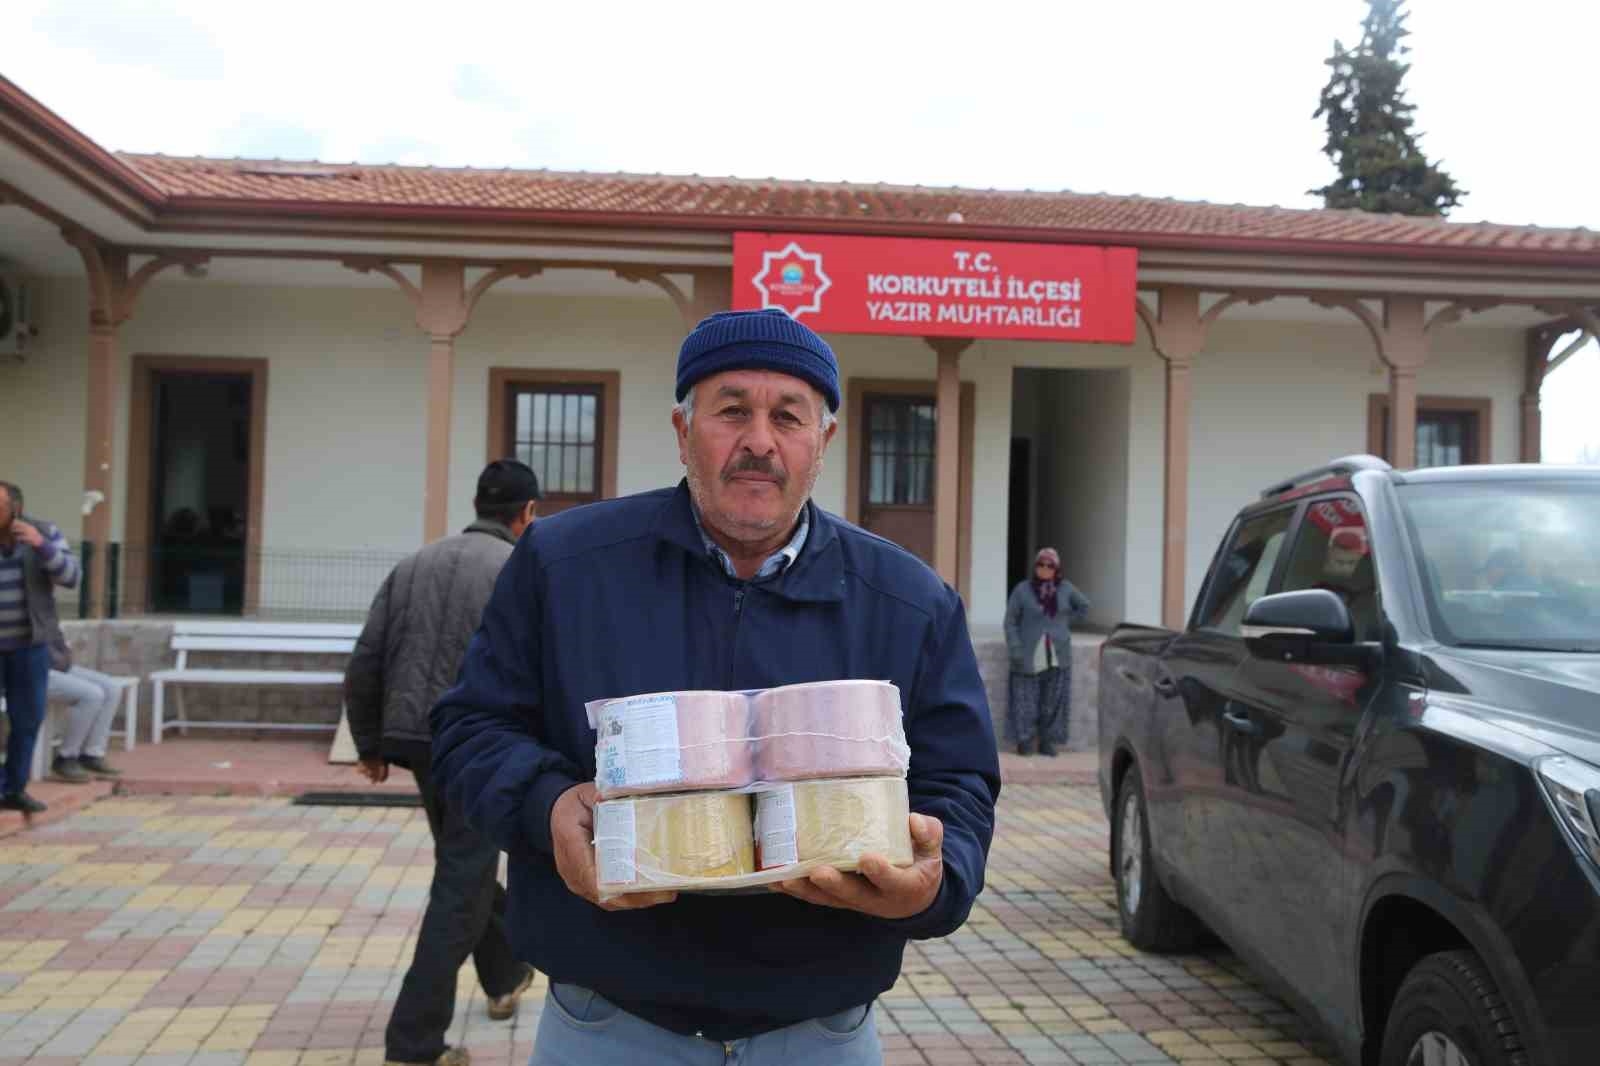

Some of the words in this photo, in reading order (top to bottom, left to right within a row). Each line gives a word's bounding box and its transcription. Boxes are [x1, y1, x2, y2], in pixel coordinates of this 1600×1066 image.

[953, 251, 998, 272] T.C.
[867, 274, 1001, 299] KORKUTELİ
[1007, 276, 1082, 303] İLÇESİ
[866, 301, 932, 322] YAZIR
[936, 304, 1081, 327] MUHTARLIĞI
